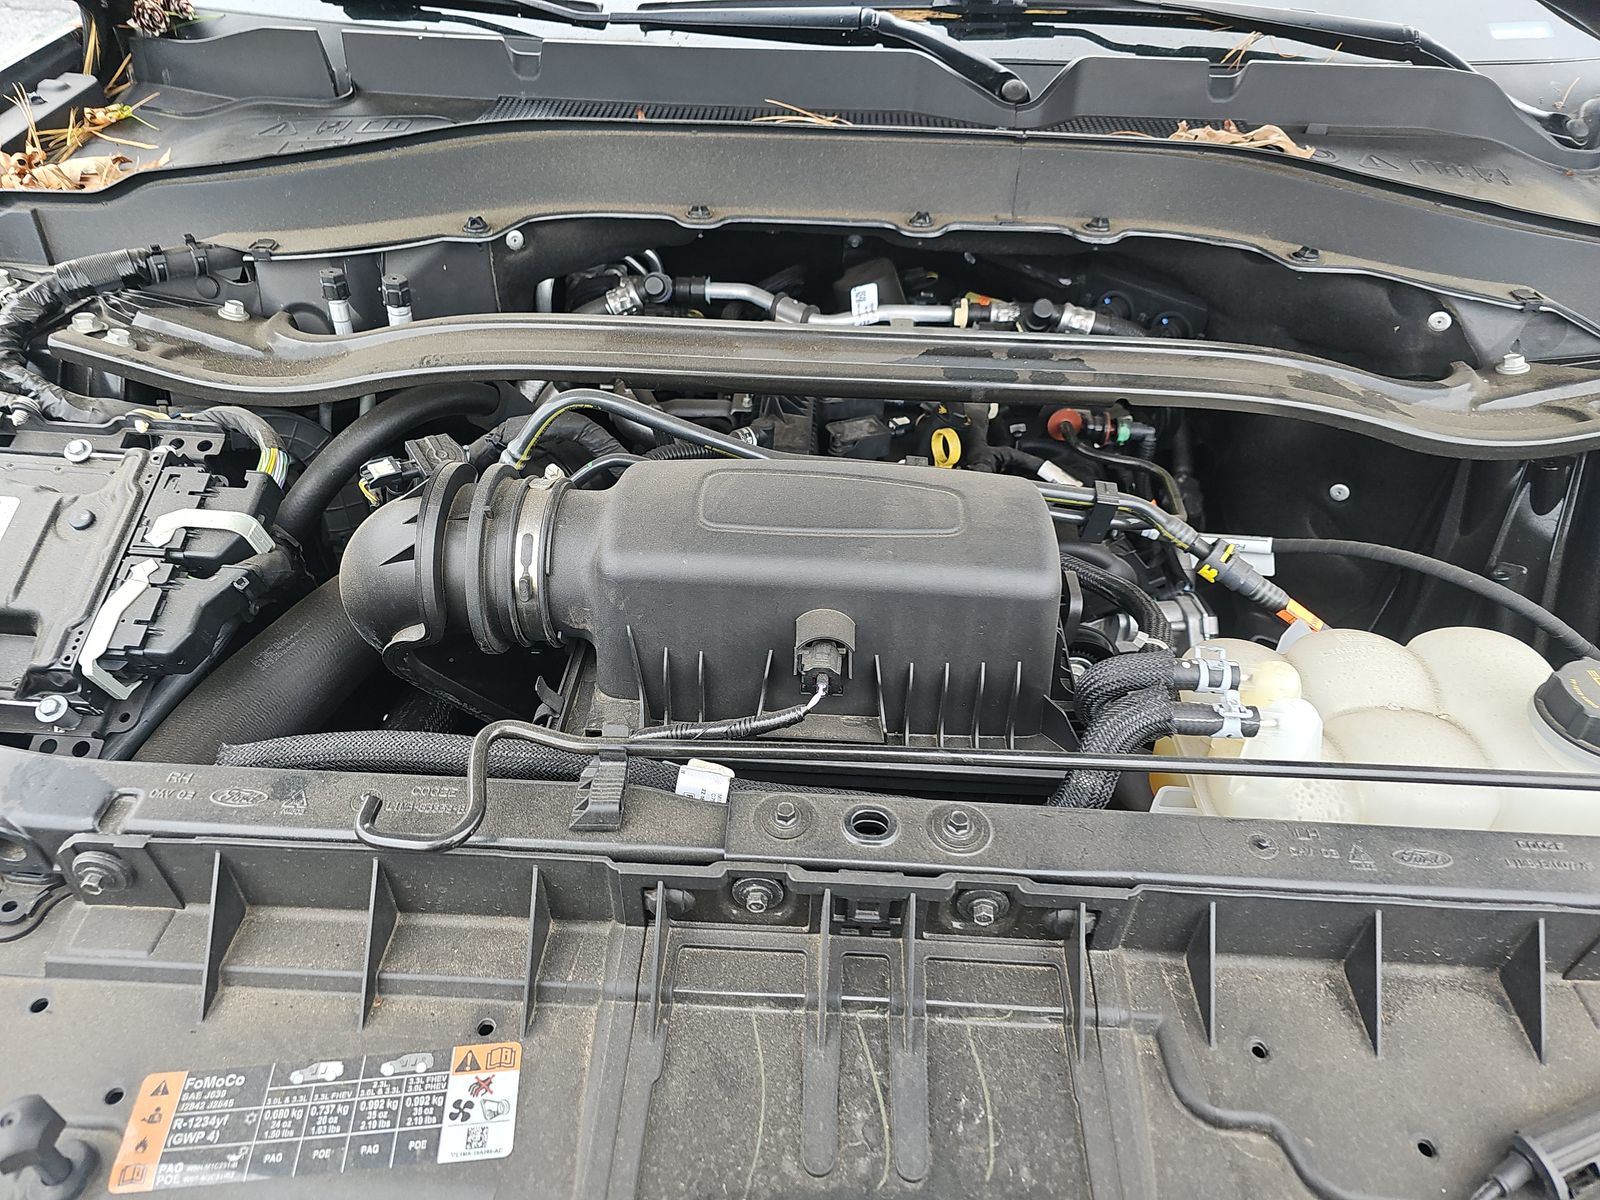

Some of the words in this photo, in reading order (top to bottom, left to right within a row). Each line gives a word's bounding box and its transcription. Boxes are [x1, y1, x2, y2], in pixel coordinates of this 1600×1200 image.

[166, 771, 195, 784] RH
[184, 1073, 246, 1091] FoMoCo
[360, 1099, 386, 1112] 0.992
[386, 1098, 398, 1110] kg
[405, 1095, 430, 1108] 0.992
[432, 1094, 444, 1106] kg
[264, 1108, 290, 1120] 0.680
[291, 1108, 304, 1120] kg
[310, 1104, 336, 1117] 0.737
[336, 1104, 350, 1116] kg
[366, 1110, 378, 1120] 35
[424, 1107, 434, 1115] oz
[172, 1114, 230, 1130] R-1234yf
[270, 1121, 280, 1130] 24
[328, 1116, 338, 1124] oz
[360, 1121, 377, 1130] 2.19
[378, 1120, 391, 1128] lbs
[424, 1116, 436, 1124] lbs
[282, 1129, 294, 1138] lbs
[328, 1124, 340, 1134] lbs
[166, 1131, 206, 1148] (GWP
[206, 1130, 220, 1144] 4)
[360, 1144, 380, 1155] PAG
[408, 1140, 428, 1152] POE
[263, 1152, 283, 1164] PAG
[312, 1148, 332, 1160] POE
[158, 1162, 184, 1174] PAG
